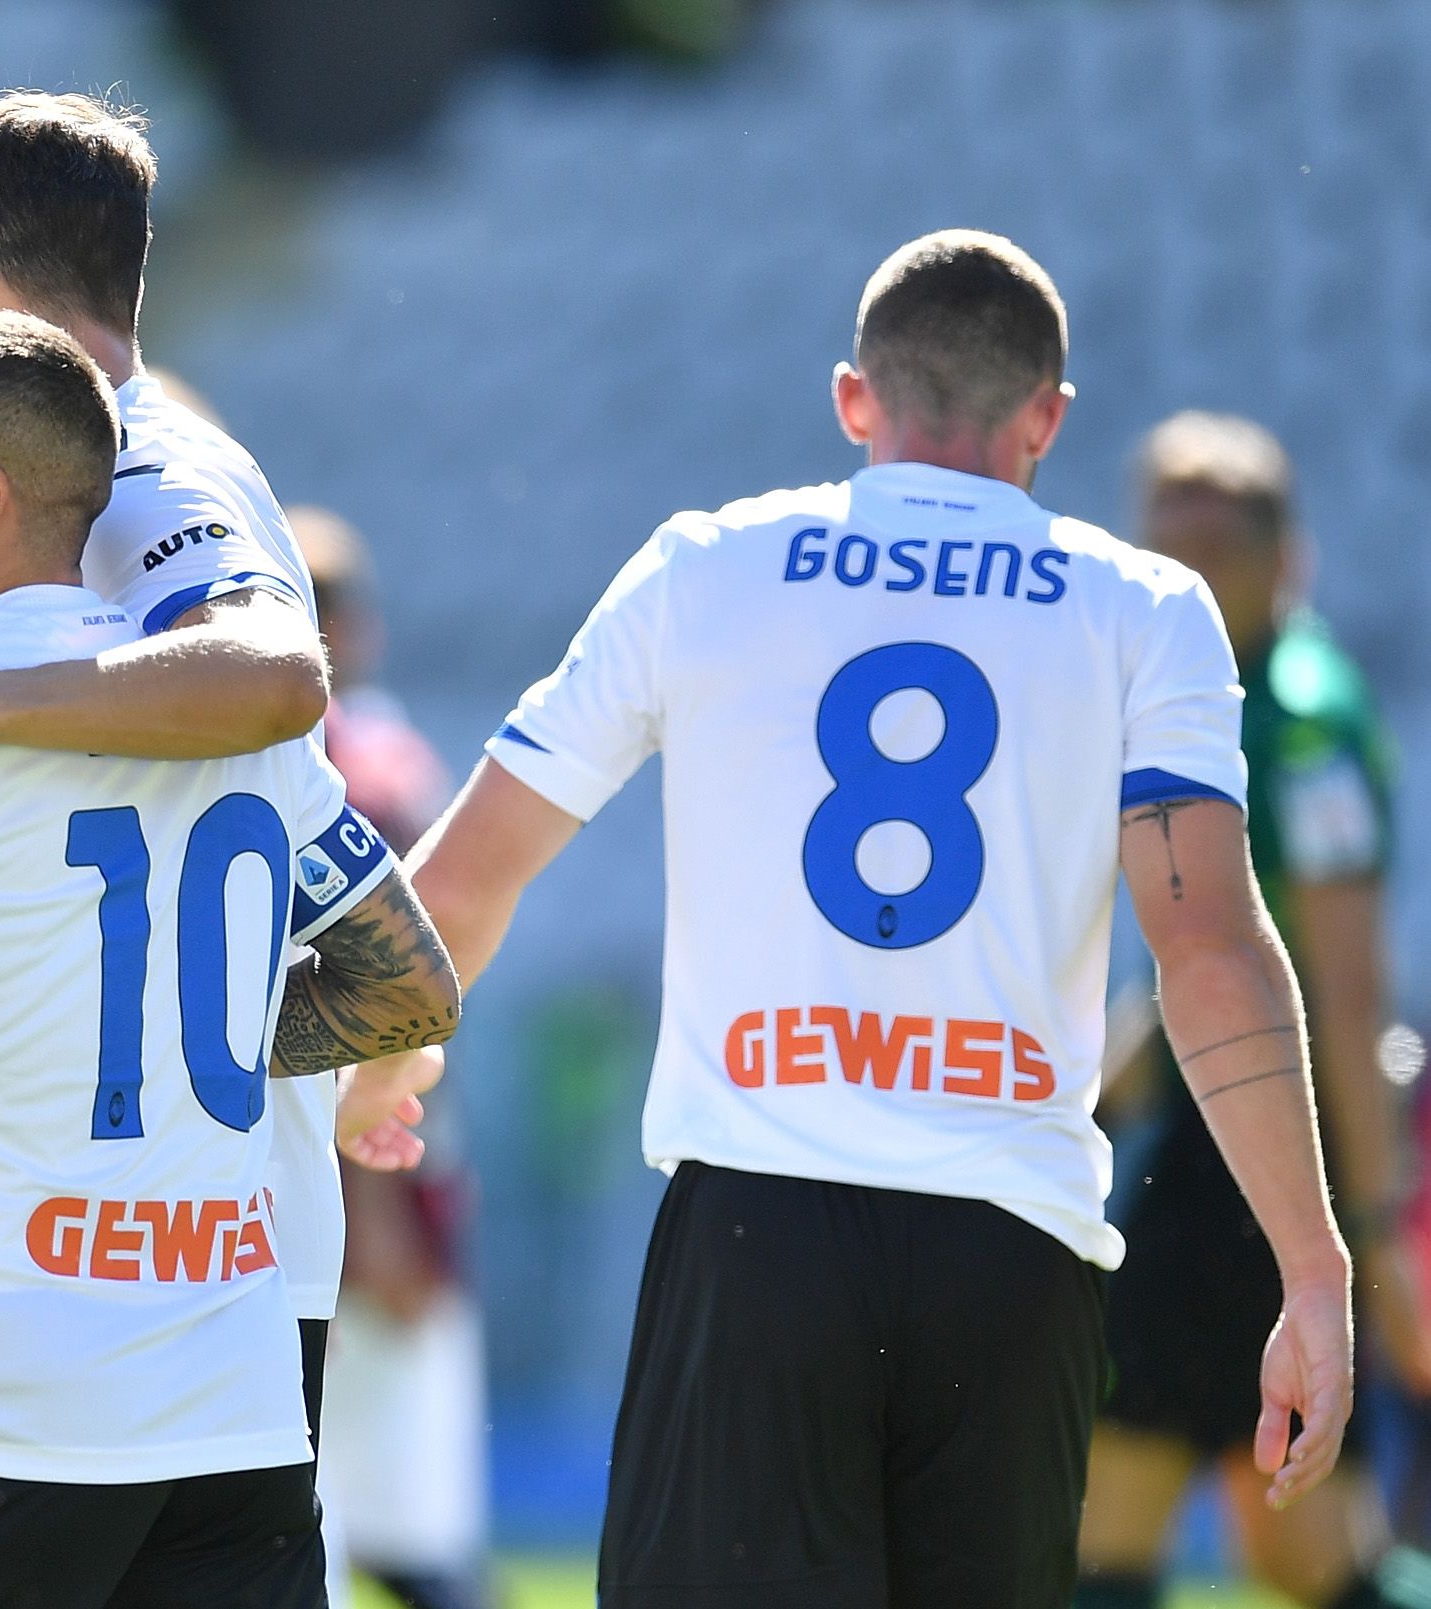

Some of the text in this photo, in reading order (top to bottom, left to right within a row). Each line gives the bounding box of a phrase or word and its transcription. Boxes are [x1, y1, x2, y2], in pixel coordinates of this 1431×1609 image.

[784, 528, 1068, 603] GOSENS
[803, 642, 1000, 949] 8
[318, 884, 338, 901] SERIE
[65, 792, 291, 1140] 10
[26, 1187, 278, 1282] GEWIS
